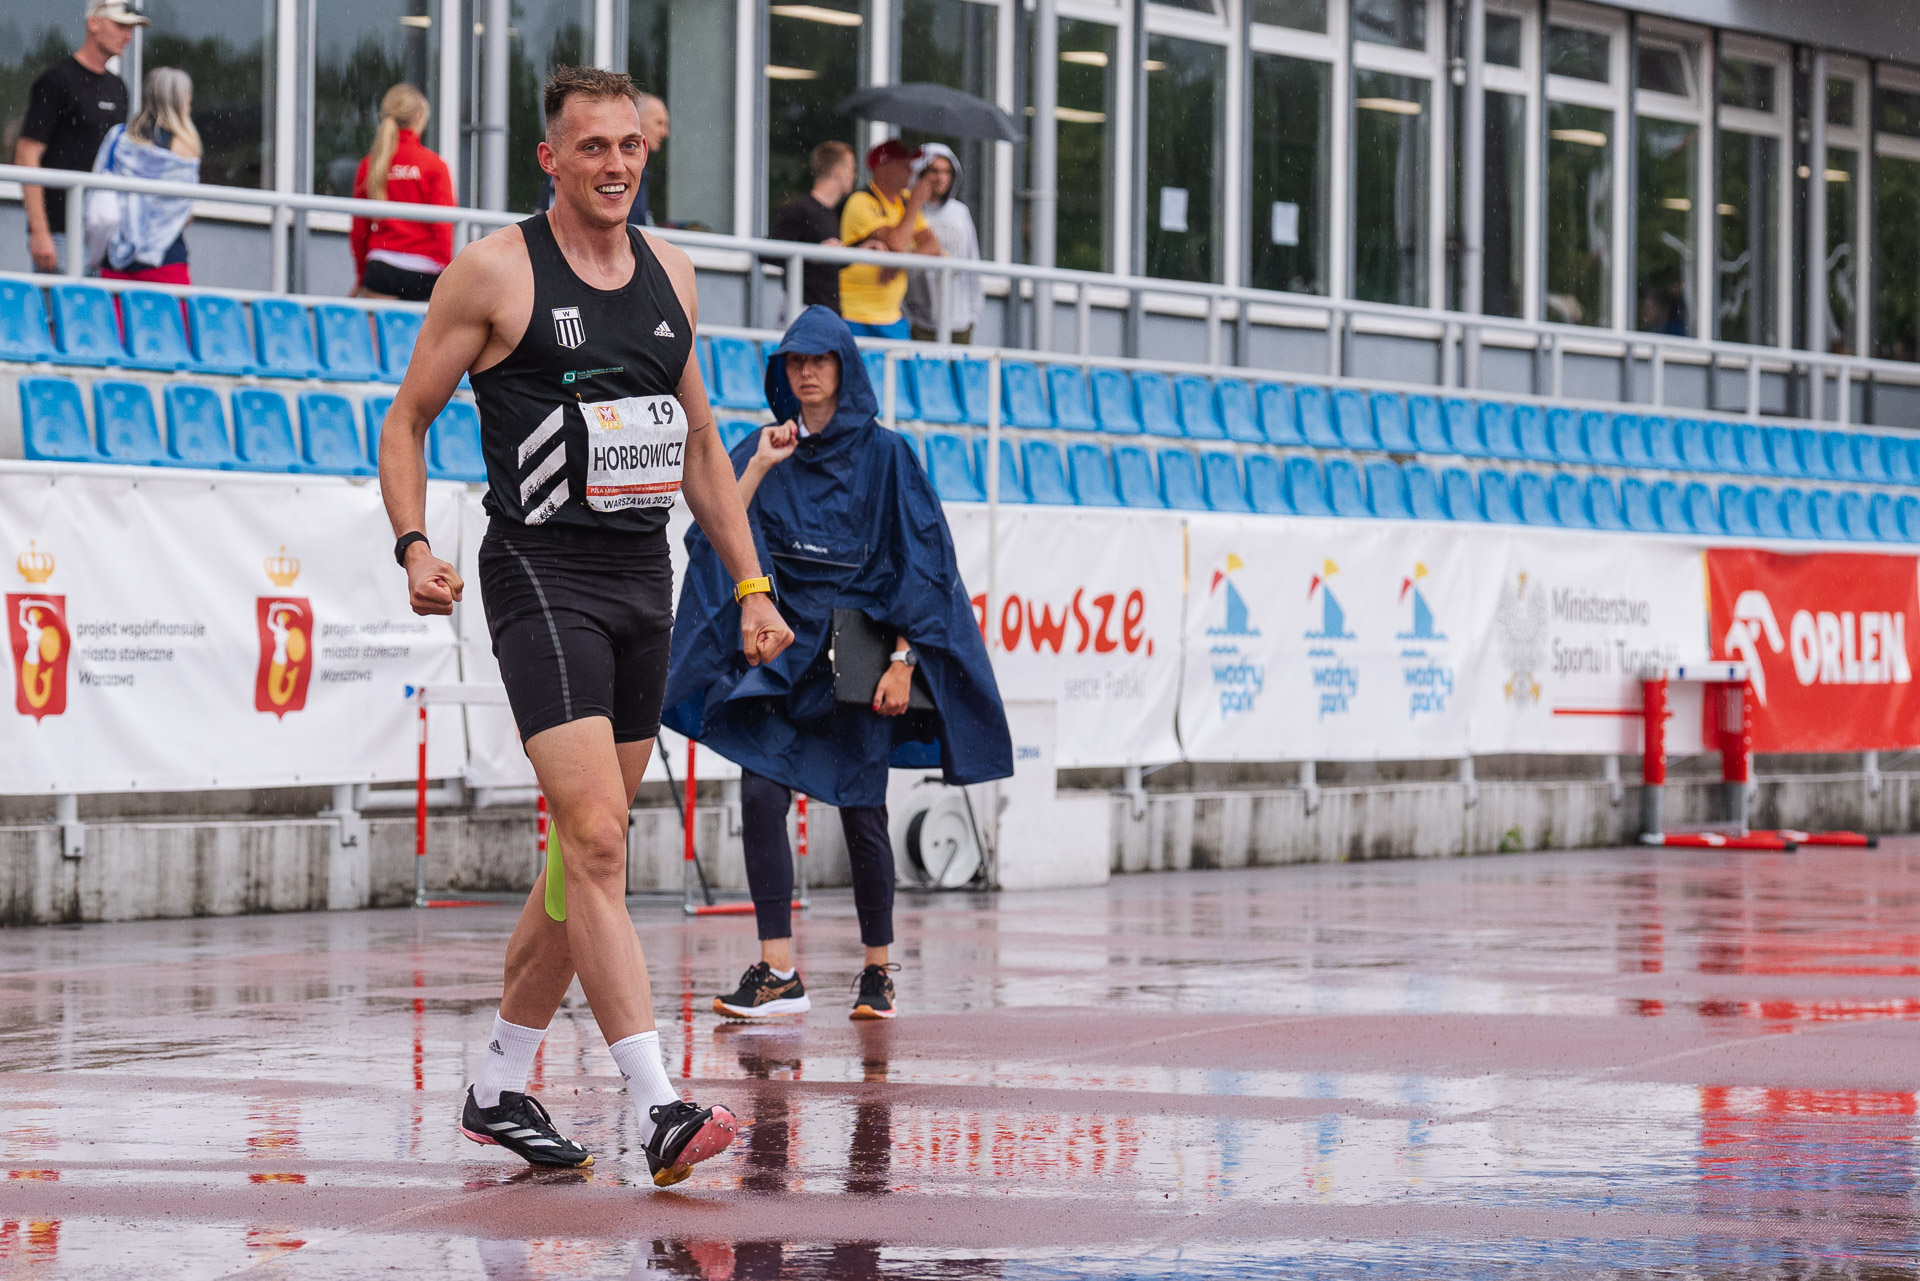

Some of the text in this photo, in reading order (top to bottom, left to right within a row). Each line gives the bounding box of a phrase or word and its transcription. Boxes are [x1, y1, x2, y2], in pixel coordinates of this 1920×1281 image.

[653, 330, 675, 338] adidas
[648, 400, 674, 425] 19
[593, 442, 683, 471] HORBOWICZ
[603, 496, 672, 509] WARSZAWA 2025
[1551, 587, 1651, 627] Ministerstwo
[77, 622, 117, 640] projekt
[1790, 608, 1912, 686] ORLEN
[1551, 637, 1602, 680] Sportu
[78, 667, 134, 687] Warszawa
[320, 666, 372, 683] Warszawa
